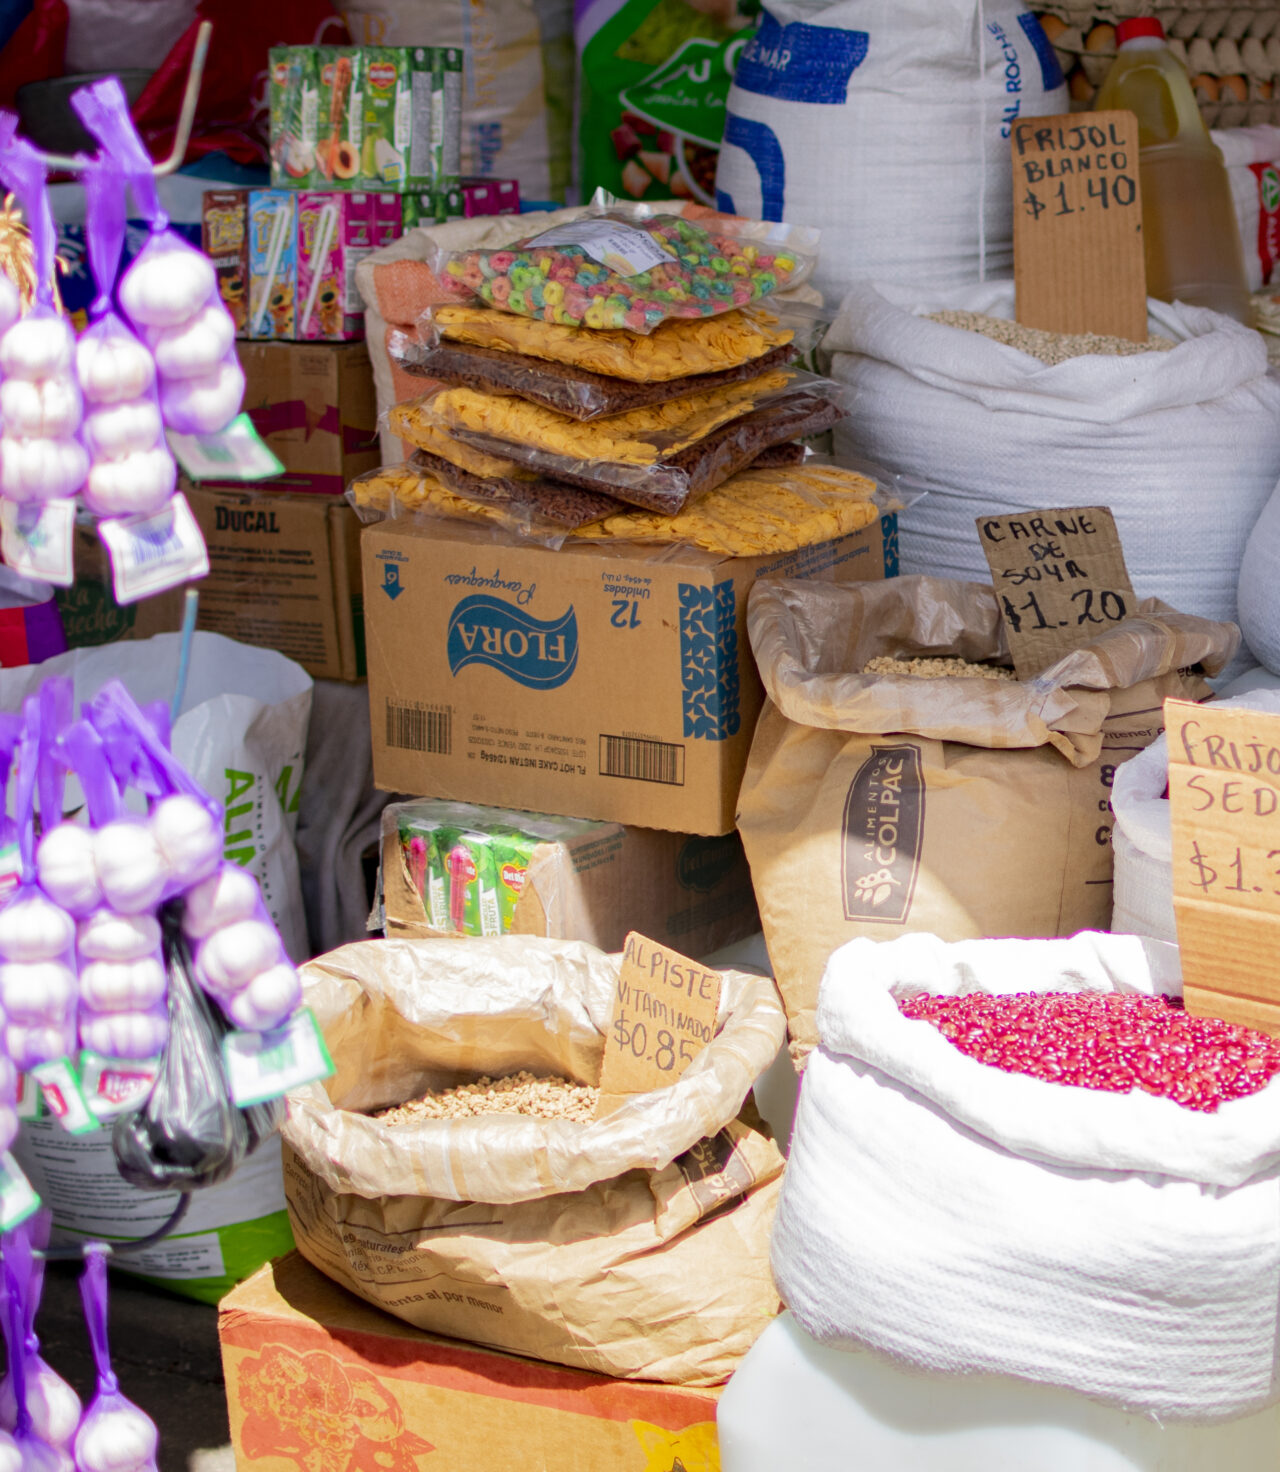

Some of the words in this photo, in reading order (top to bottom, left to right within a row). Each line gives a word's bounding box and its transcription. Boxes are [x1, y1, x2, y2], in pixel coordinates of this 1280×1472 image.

[760, 46, 791, 72] MAR
[1015, 123, 1127, 156] FRIJOL
[1023, 151, 1128, 184] BLANCO
[1022, 174, 1136, 221] $1.40
[215, 505, 280, 533] DUCAL
[983, 515, 1097, 543] CARNE
[1028, 541, 1065, 562] DE
[444, 566, 537, 606] Panqueques
[1001, 559, 1088, 586] SOYA
[603, 584, 650, 600] Unidades
[610, 600, 642, 629] 12
[1002, 588, 1127, 633] $1.20
[456, 622, 568, 662] FLORA
[509, 756, 537, 769] INSTAN
[538, 759, 559, 771] CAKE
[559, 763, 576, 774] HOT
[863, 757, 889, 861] ALIMENTOS
[876, 758, 905, 866] COLPAC
[625, 937, 716, 1000] ALPISTE
[617, 979, 712, 1044] VITAMINADO
[613, 1009, 696, 1076] $0.85
[689, 1141, 732, 1198] OLPA
[426, 1289, 443, 1302] al
[443, 1290, 465, 1307] por
[466, 1294, 505, 1315] menor
